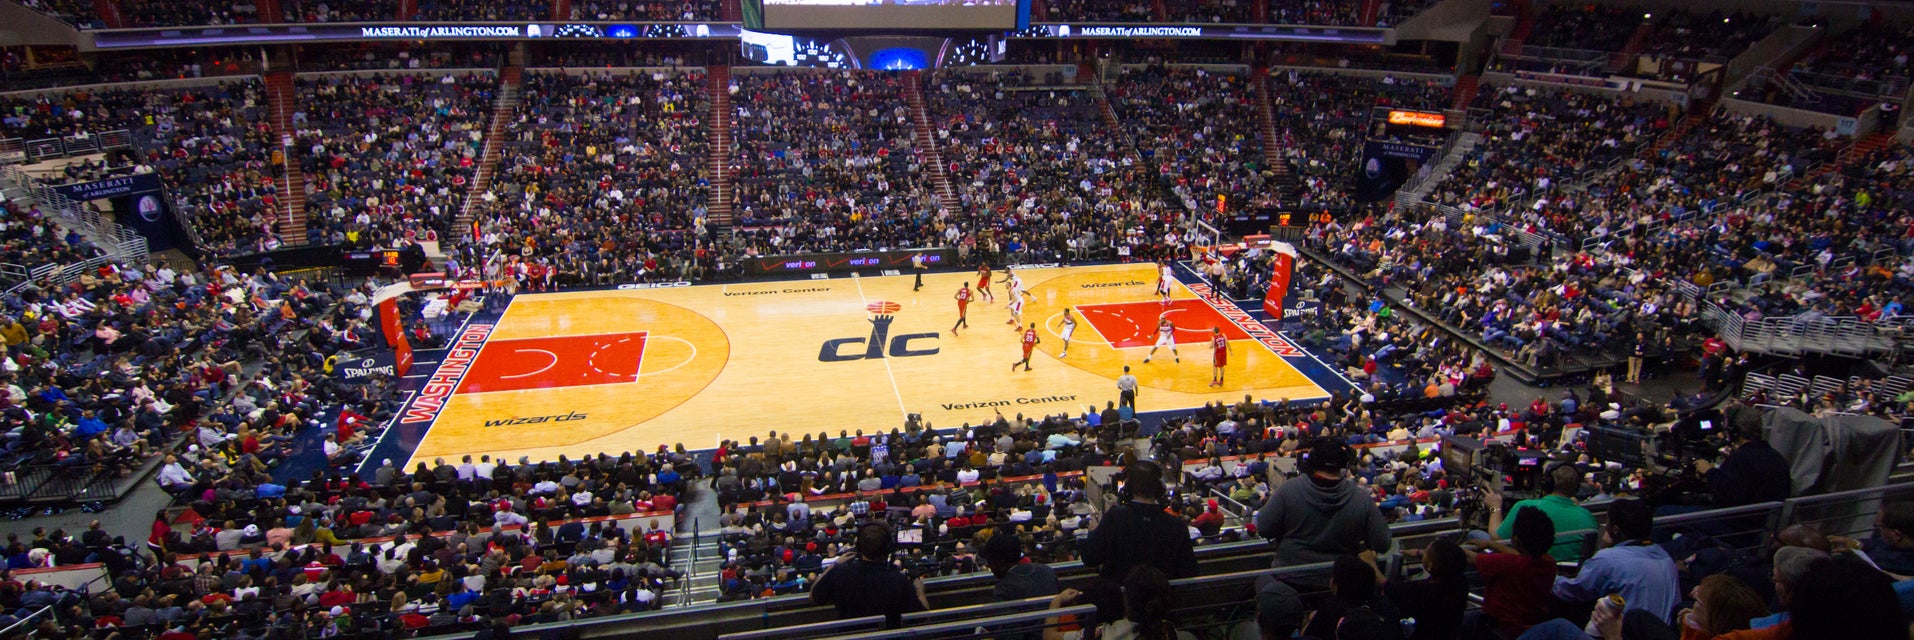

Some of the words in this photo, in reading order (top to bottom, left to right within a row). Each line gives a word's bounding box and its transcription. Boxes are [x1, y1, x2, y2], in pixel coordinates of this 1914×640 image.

[362, 27, 420, 37] MASERATI
[430, 27, 519, 37] ARLINGTON.COM
[1082, 27, 1125, 36] MASERATI
[1132, 27, 1202, 36] ARLINGTON.COM
[1388, 110, 1446, 126] Budweiser
[1383, 144, 1424, 154] MASERATI
[72, 178, 134, 193] MASERATI
[90, 186, 131, 197] ARLINGTON
[850, 257, 880, 266] verizon
[911, 254, 941, 263] vrizon
[786, 260, 816, 269] verizon
[1081, 280, 1146, 288] wizards
[401, 324, 493, 424] WASHINGTON
[941, 400, 1011, 411] Verizon
[1016, 394, 1077, 405] Center
[484, 410, 589, 427] wizards
